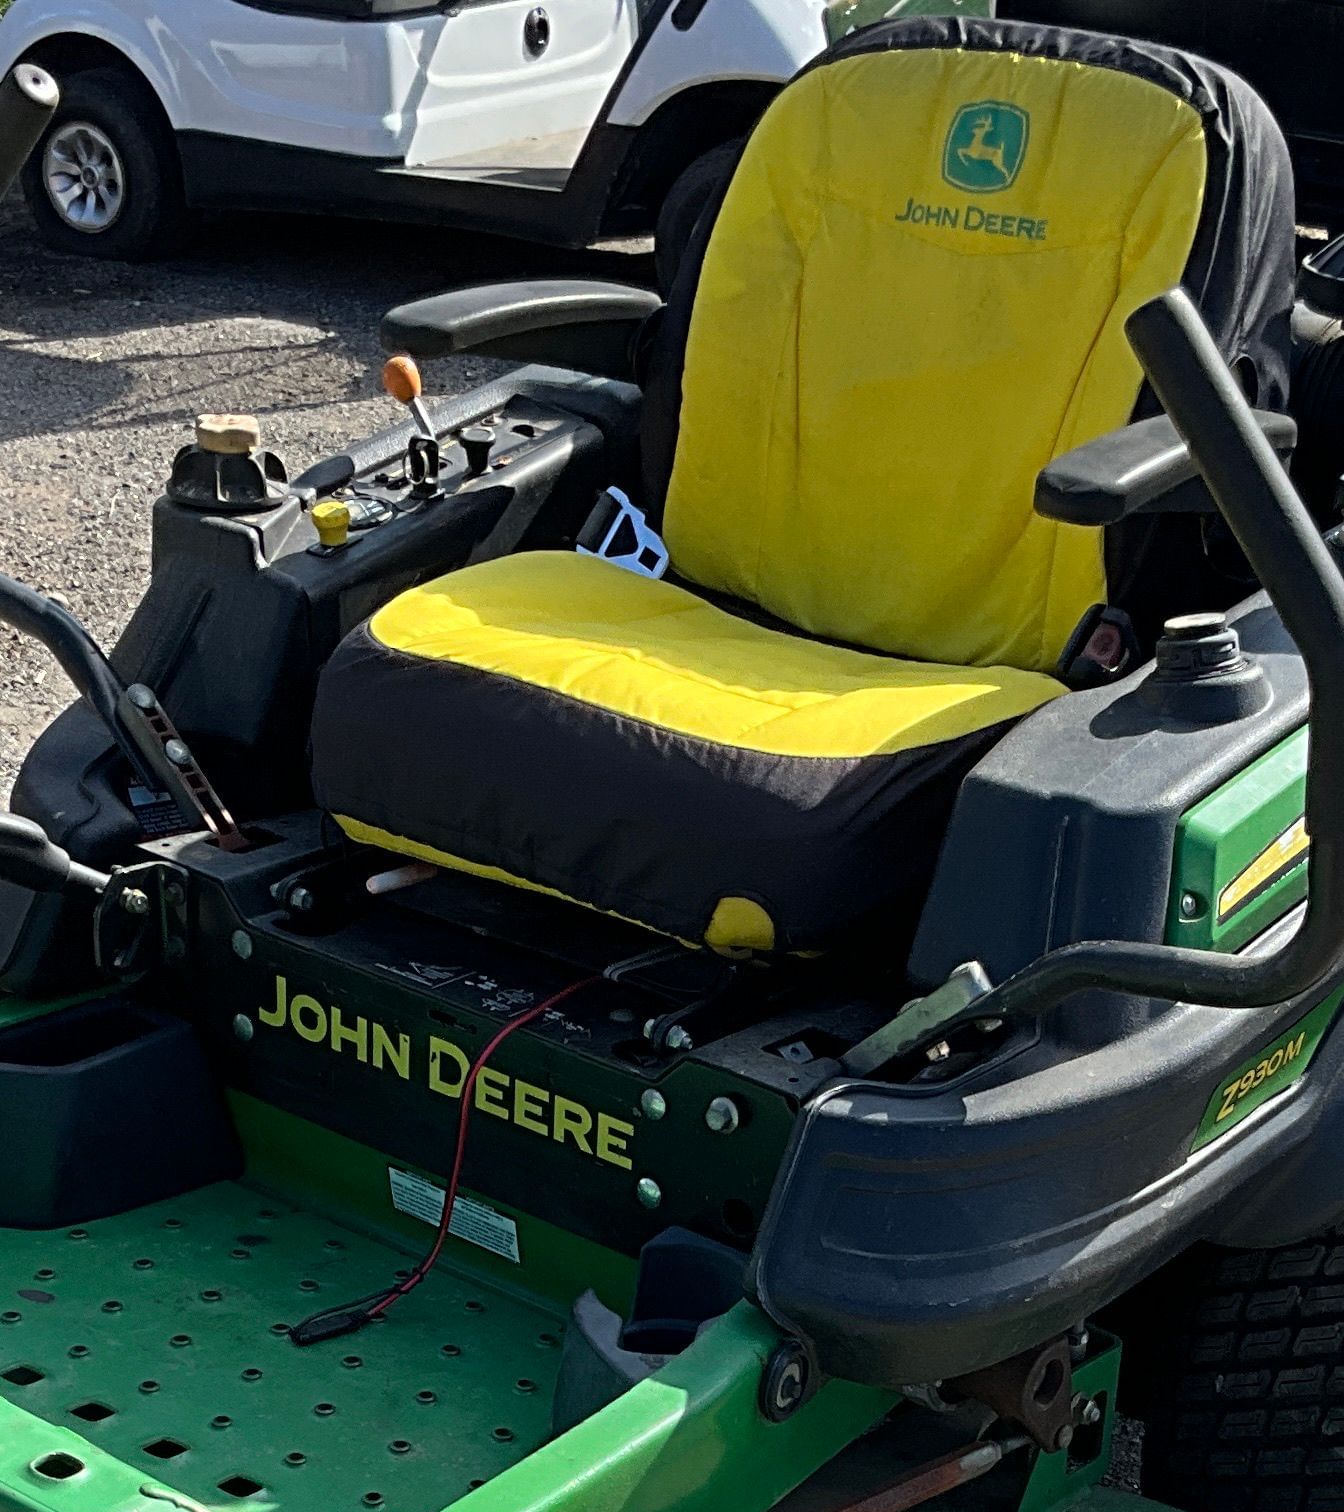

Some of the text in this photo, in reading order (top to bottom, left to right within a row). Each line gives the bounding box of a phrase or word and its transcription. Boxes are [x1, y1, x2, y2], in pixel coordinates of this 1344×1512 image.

[895, 198, 1048, 240] JOHN DEERE
[259, 975, 634, 1170] JOHN DEERE
[1215, 1031, 1306, 1122] Z930M
